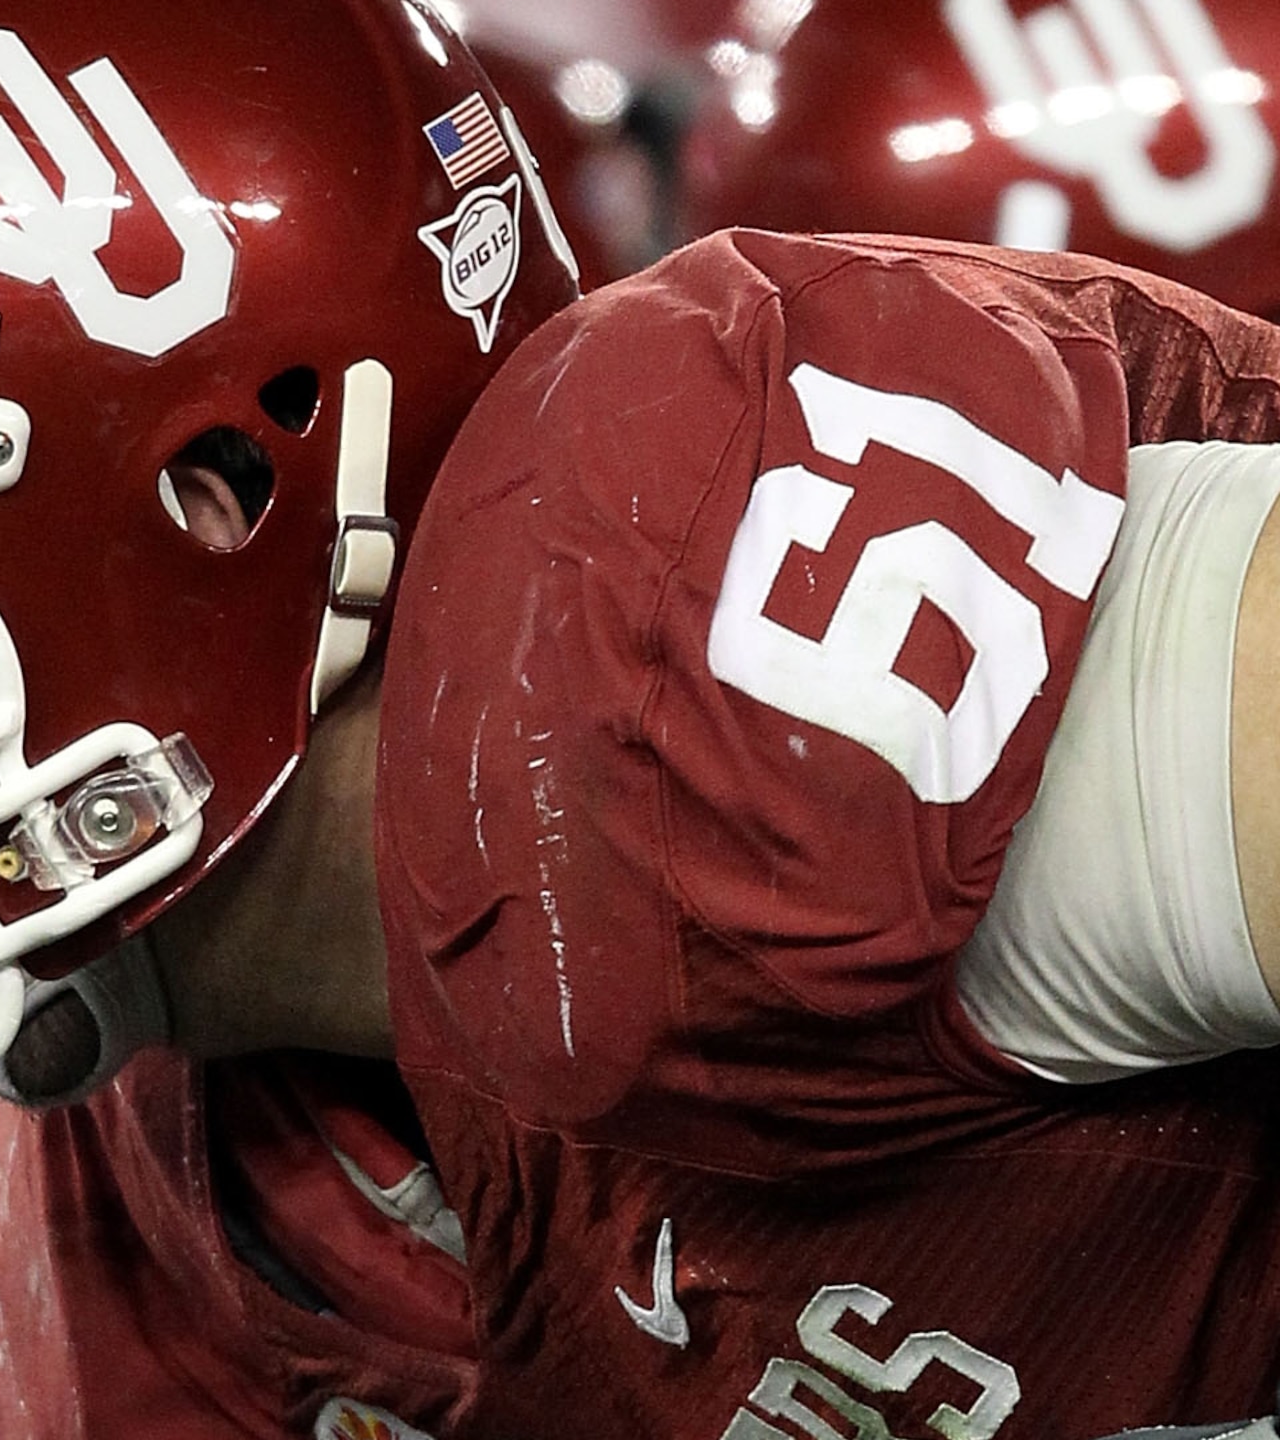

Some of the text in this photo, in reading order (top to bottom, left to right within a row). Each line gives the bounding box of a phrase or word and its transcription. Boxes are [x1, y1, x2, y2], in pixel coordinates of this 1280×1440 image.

[455, 222, 511, 284] BIG 12
[707, 362, 1126, 804] 61
